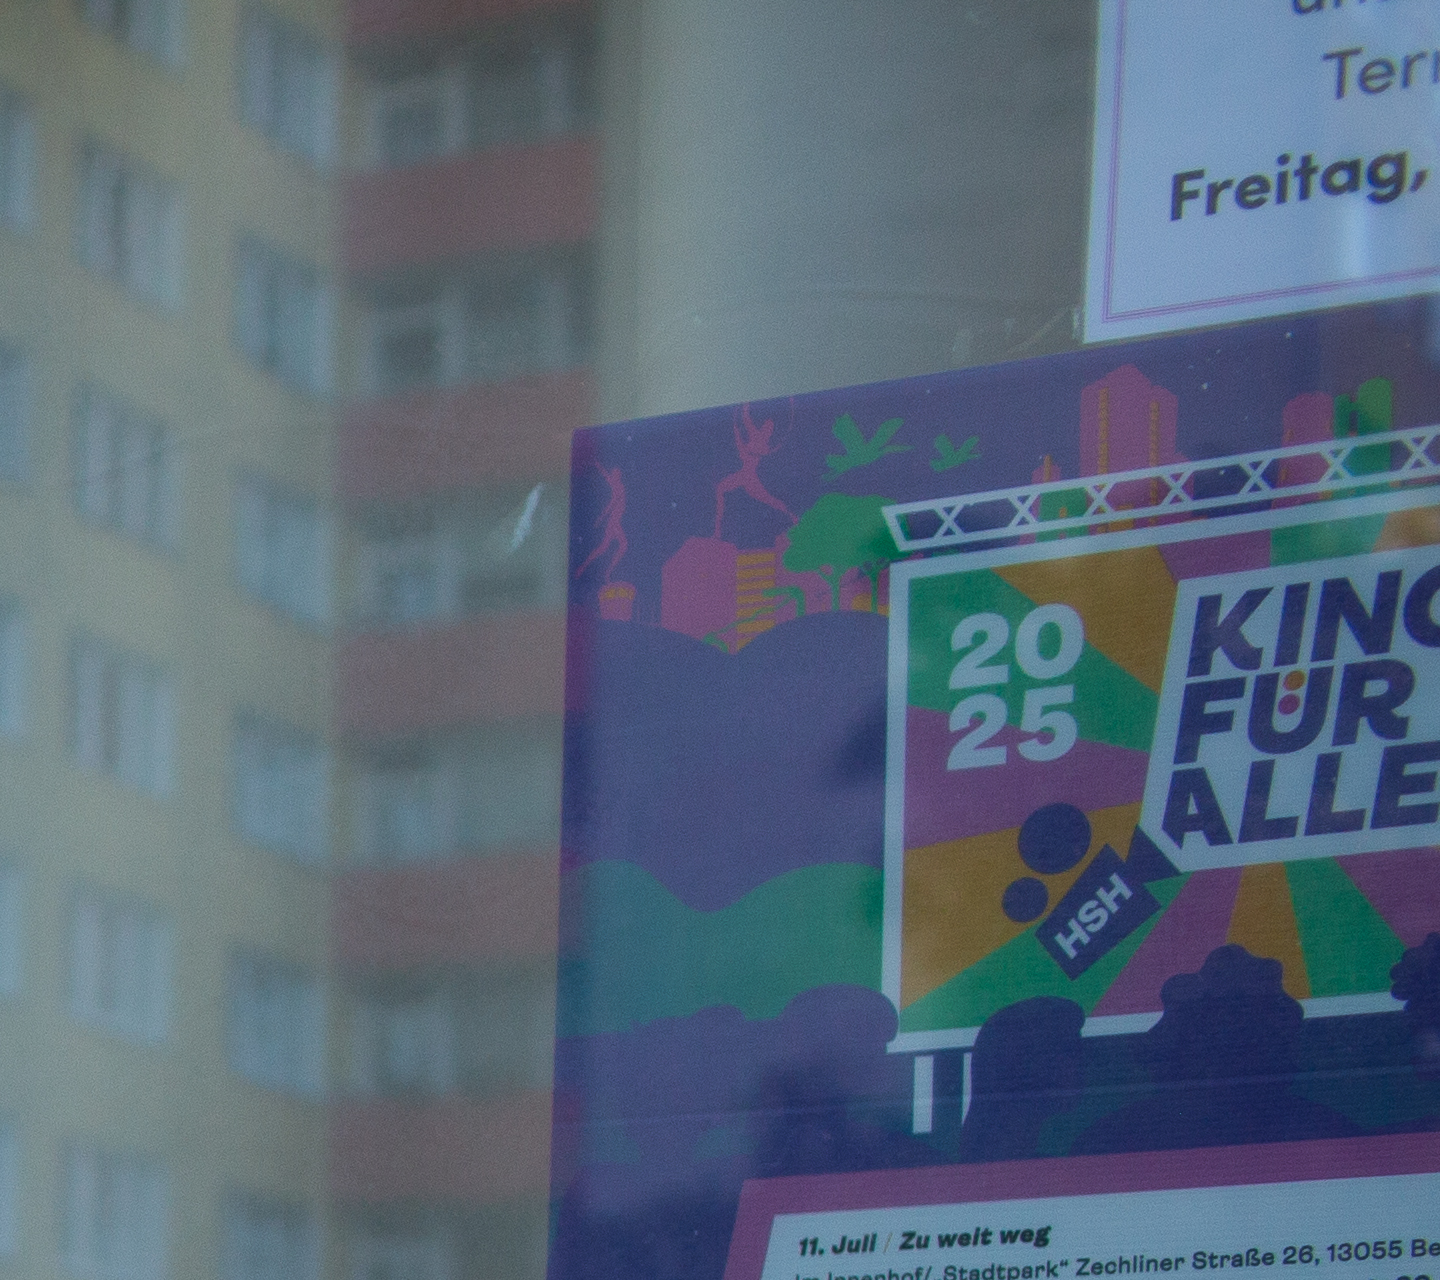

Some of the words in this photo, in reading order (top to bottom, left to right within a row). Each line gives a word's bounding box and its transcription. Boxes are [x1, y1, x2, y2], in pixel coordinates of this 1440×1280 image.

[1322, 46, 1440, 100] Ter
[1169, 151, 1430, 222] Freitag,
[949, 603, 1085, 690] 20
[947, 684, 1078, 770] 25
[1173, 658, 1415, 766] FÜR
[1161, 740, 1440, 850] ALLE
[1054, 872, 1134, 960] HSH
[799, 1236, 825, 1257] 11.
[831, 1232, 878, 1255] Juli
[898, 1229, 931, 1251] Zu
[937, 1226, 993, 1249] weit
[999, 1224, 1052, 1249] weg
[1075, 1254, 1186, 1277] Zechliner
[1191, 1247, 1276, 1271] Straße
[1282, 1244, 1321, 1266] 26,
[1326, 1238, 1404, 1263] 13055
